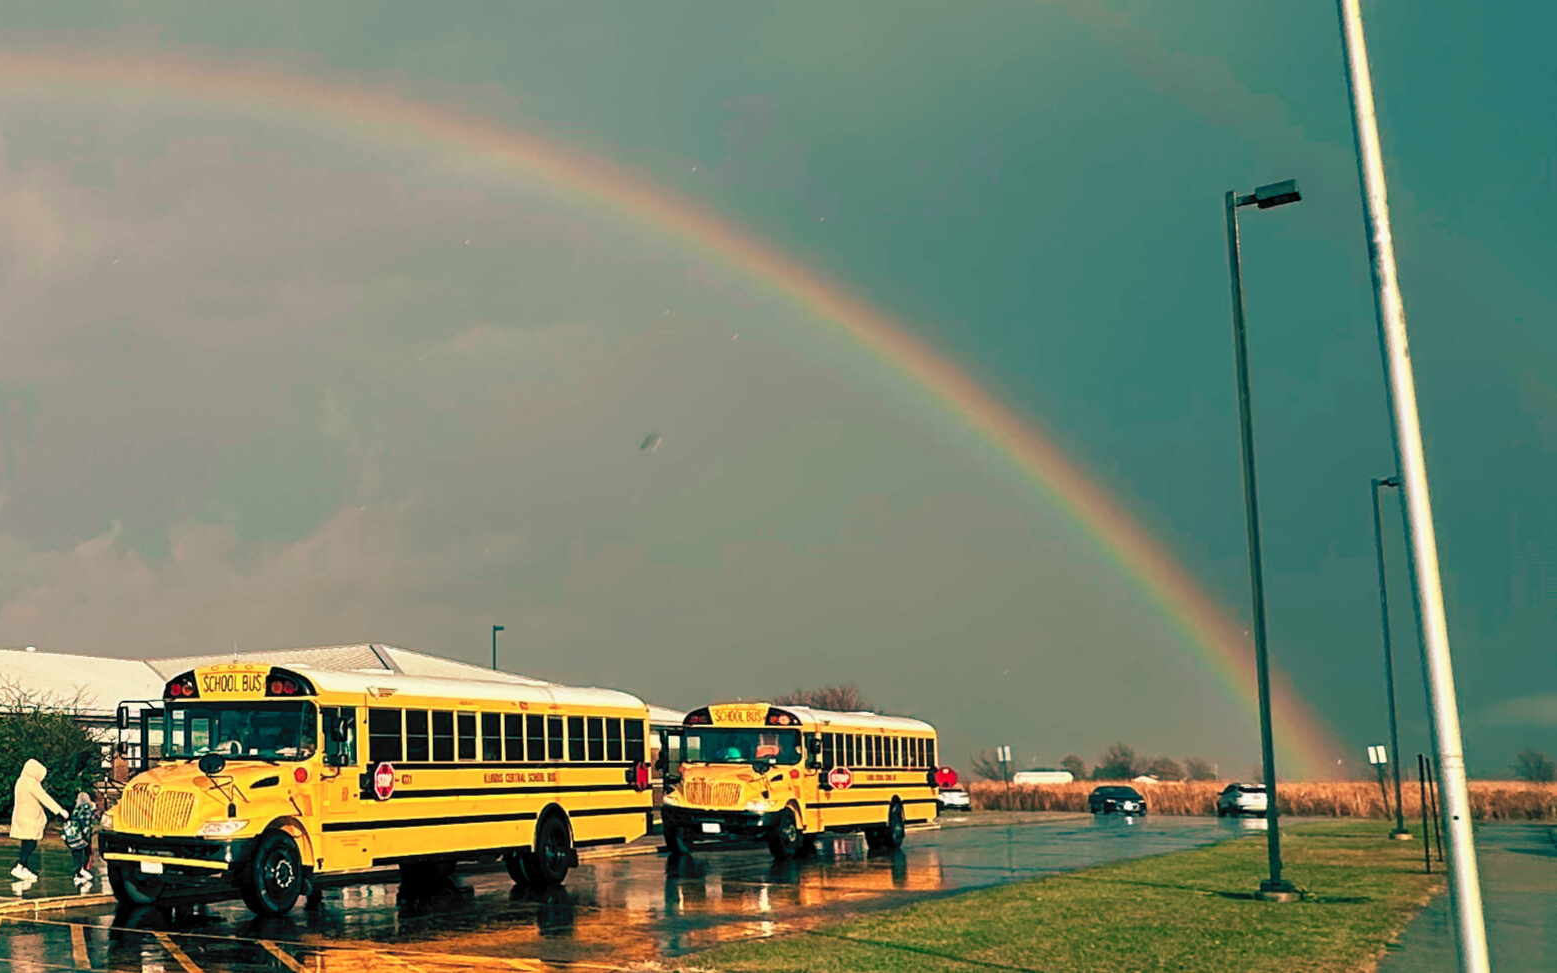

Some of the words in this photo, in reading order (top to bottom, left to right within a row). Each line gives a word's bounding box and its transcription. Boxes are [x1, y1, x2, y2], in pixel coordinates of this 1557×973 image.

[203, 674, 240, 693] SCHOOL
[242, 672, 262, 692] BUS
[715, 709, 744, 722] SCHOOL
[746, 709, 762, 723] BUS
[377, 773, 393, 787] STOP
[831, 773, 850, 783] STOP
